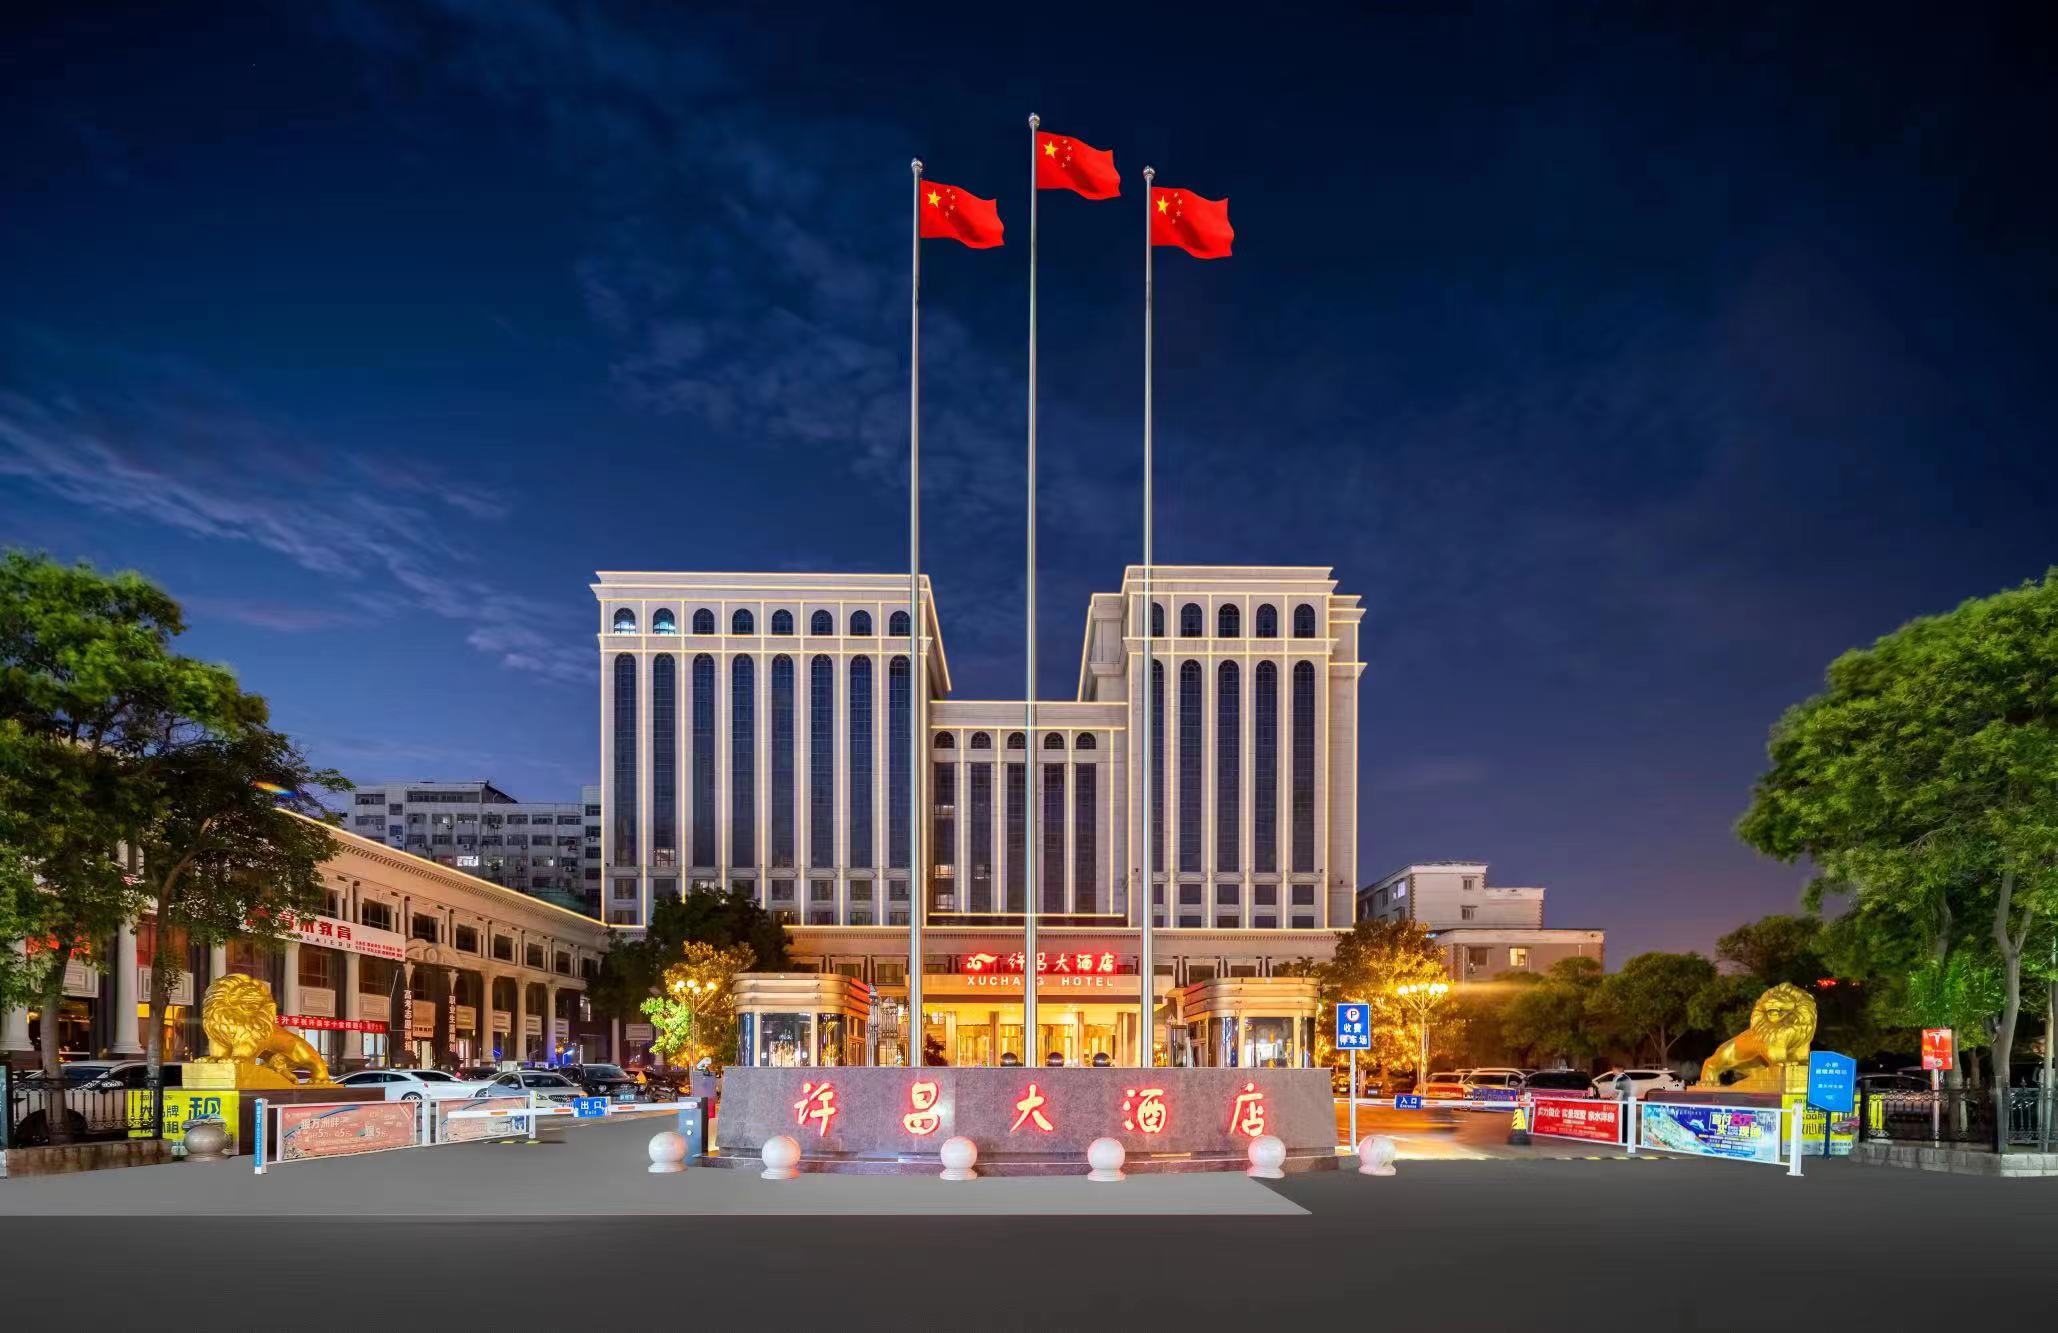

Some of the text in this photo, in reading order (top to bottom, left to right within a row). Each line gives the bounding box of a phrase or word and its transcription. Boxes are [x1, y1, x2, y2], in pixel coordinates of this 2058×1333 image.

[967, 976, 1114, 987] XUCHAG HOTEL
[1343, 1022, 1362, 1033] 收费
[1340, 1034, 1368, 1045] 停车场
[580, 1100, 602, 1110] 出口
[1401, 1096, 1418, 1105] 入口
[794, 1082, 1264, 1138] 许昌大酒店
